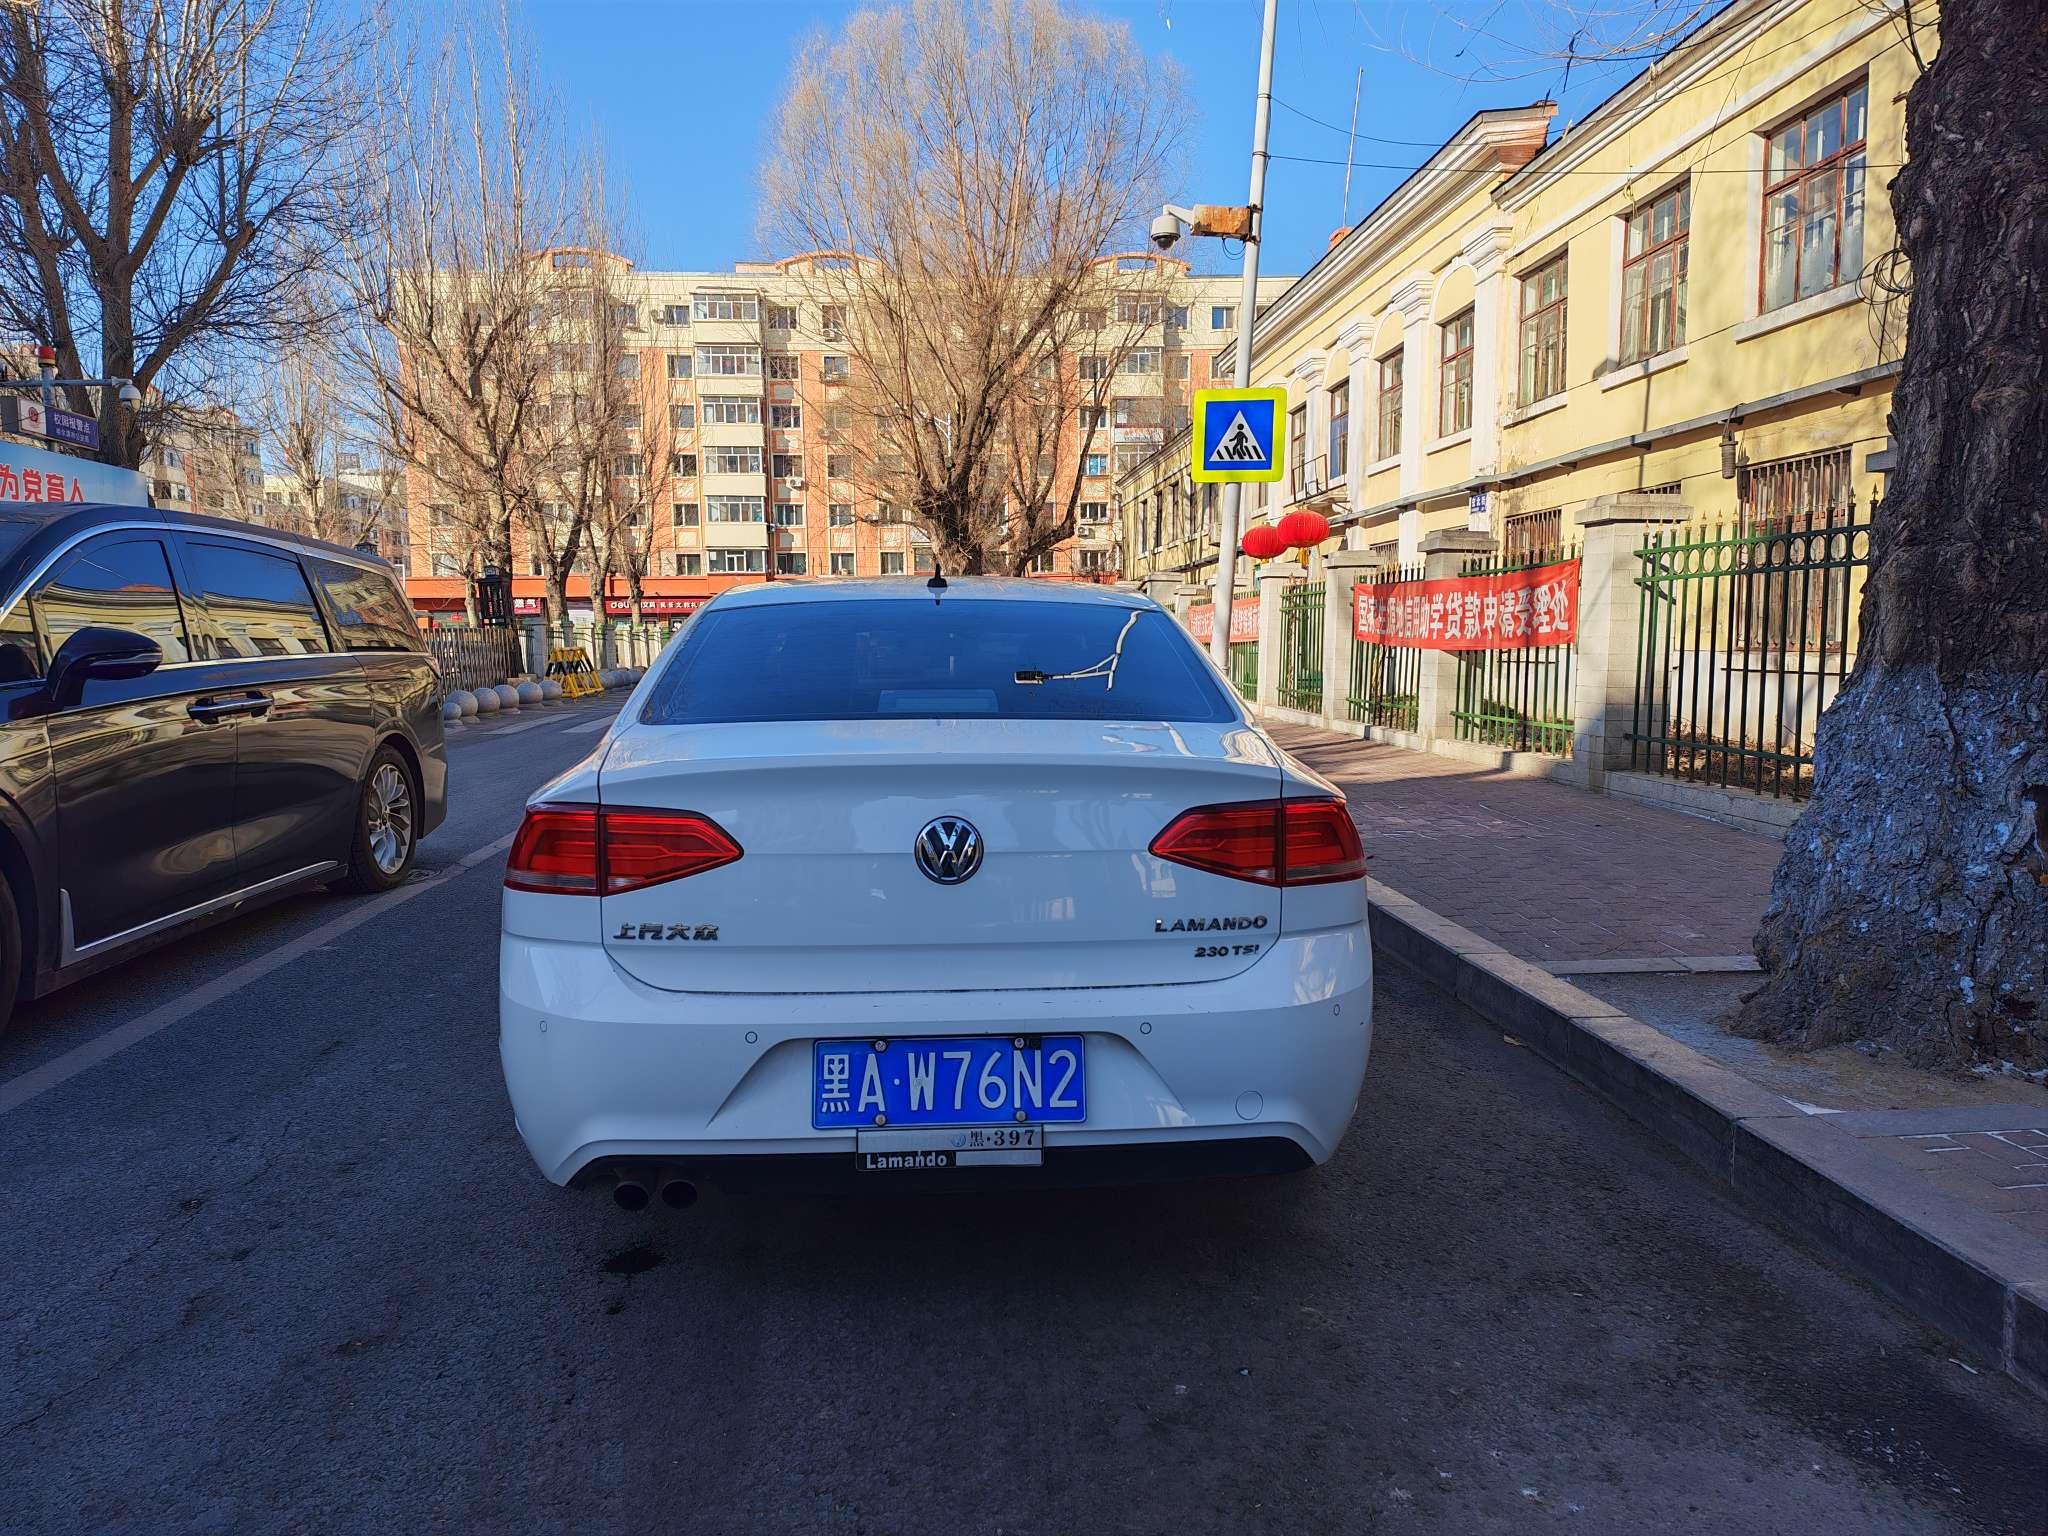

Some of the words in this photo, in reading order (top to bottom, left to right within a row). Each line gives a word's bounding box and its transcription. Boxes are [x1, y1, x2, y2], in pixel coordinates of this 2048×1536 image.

[0, 464, 84, 502] 为党育人
[1358, 579, 1569, 640] 国家生源地信用助学贷款申请受理处
[613, 921, 719, 940] 上汽大众
[1155, 916, 1268, 932] LAMANDO
[1195, 946, 1229, 957] 230
[1232, 944, 1259, 955] TSI
[821, 1049, 1078, 1113] 黑A·W76N2
[866, 1152, 948, 1169] Lamando
